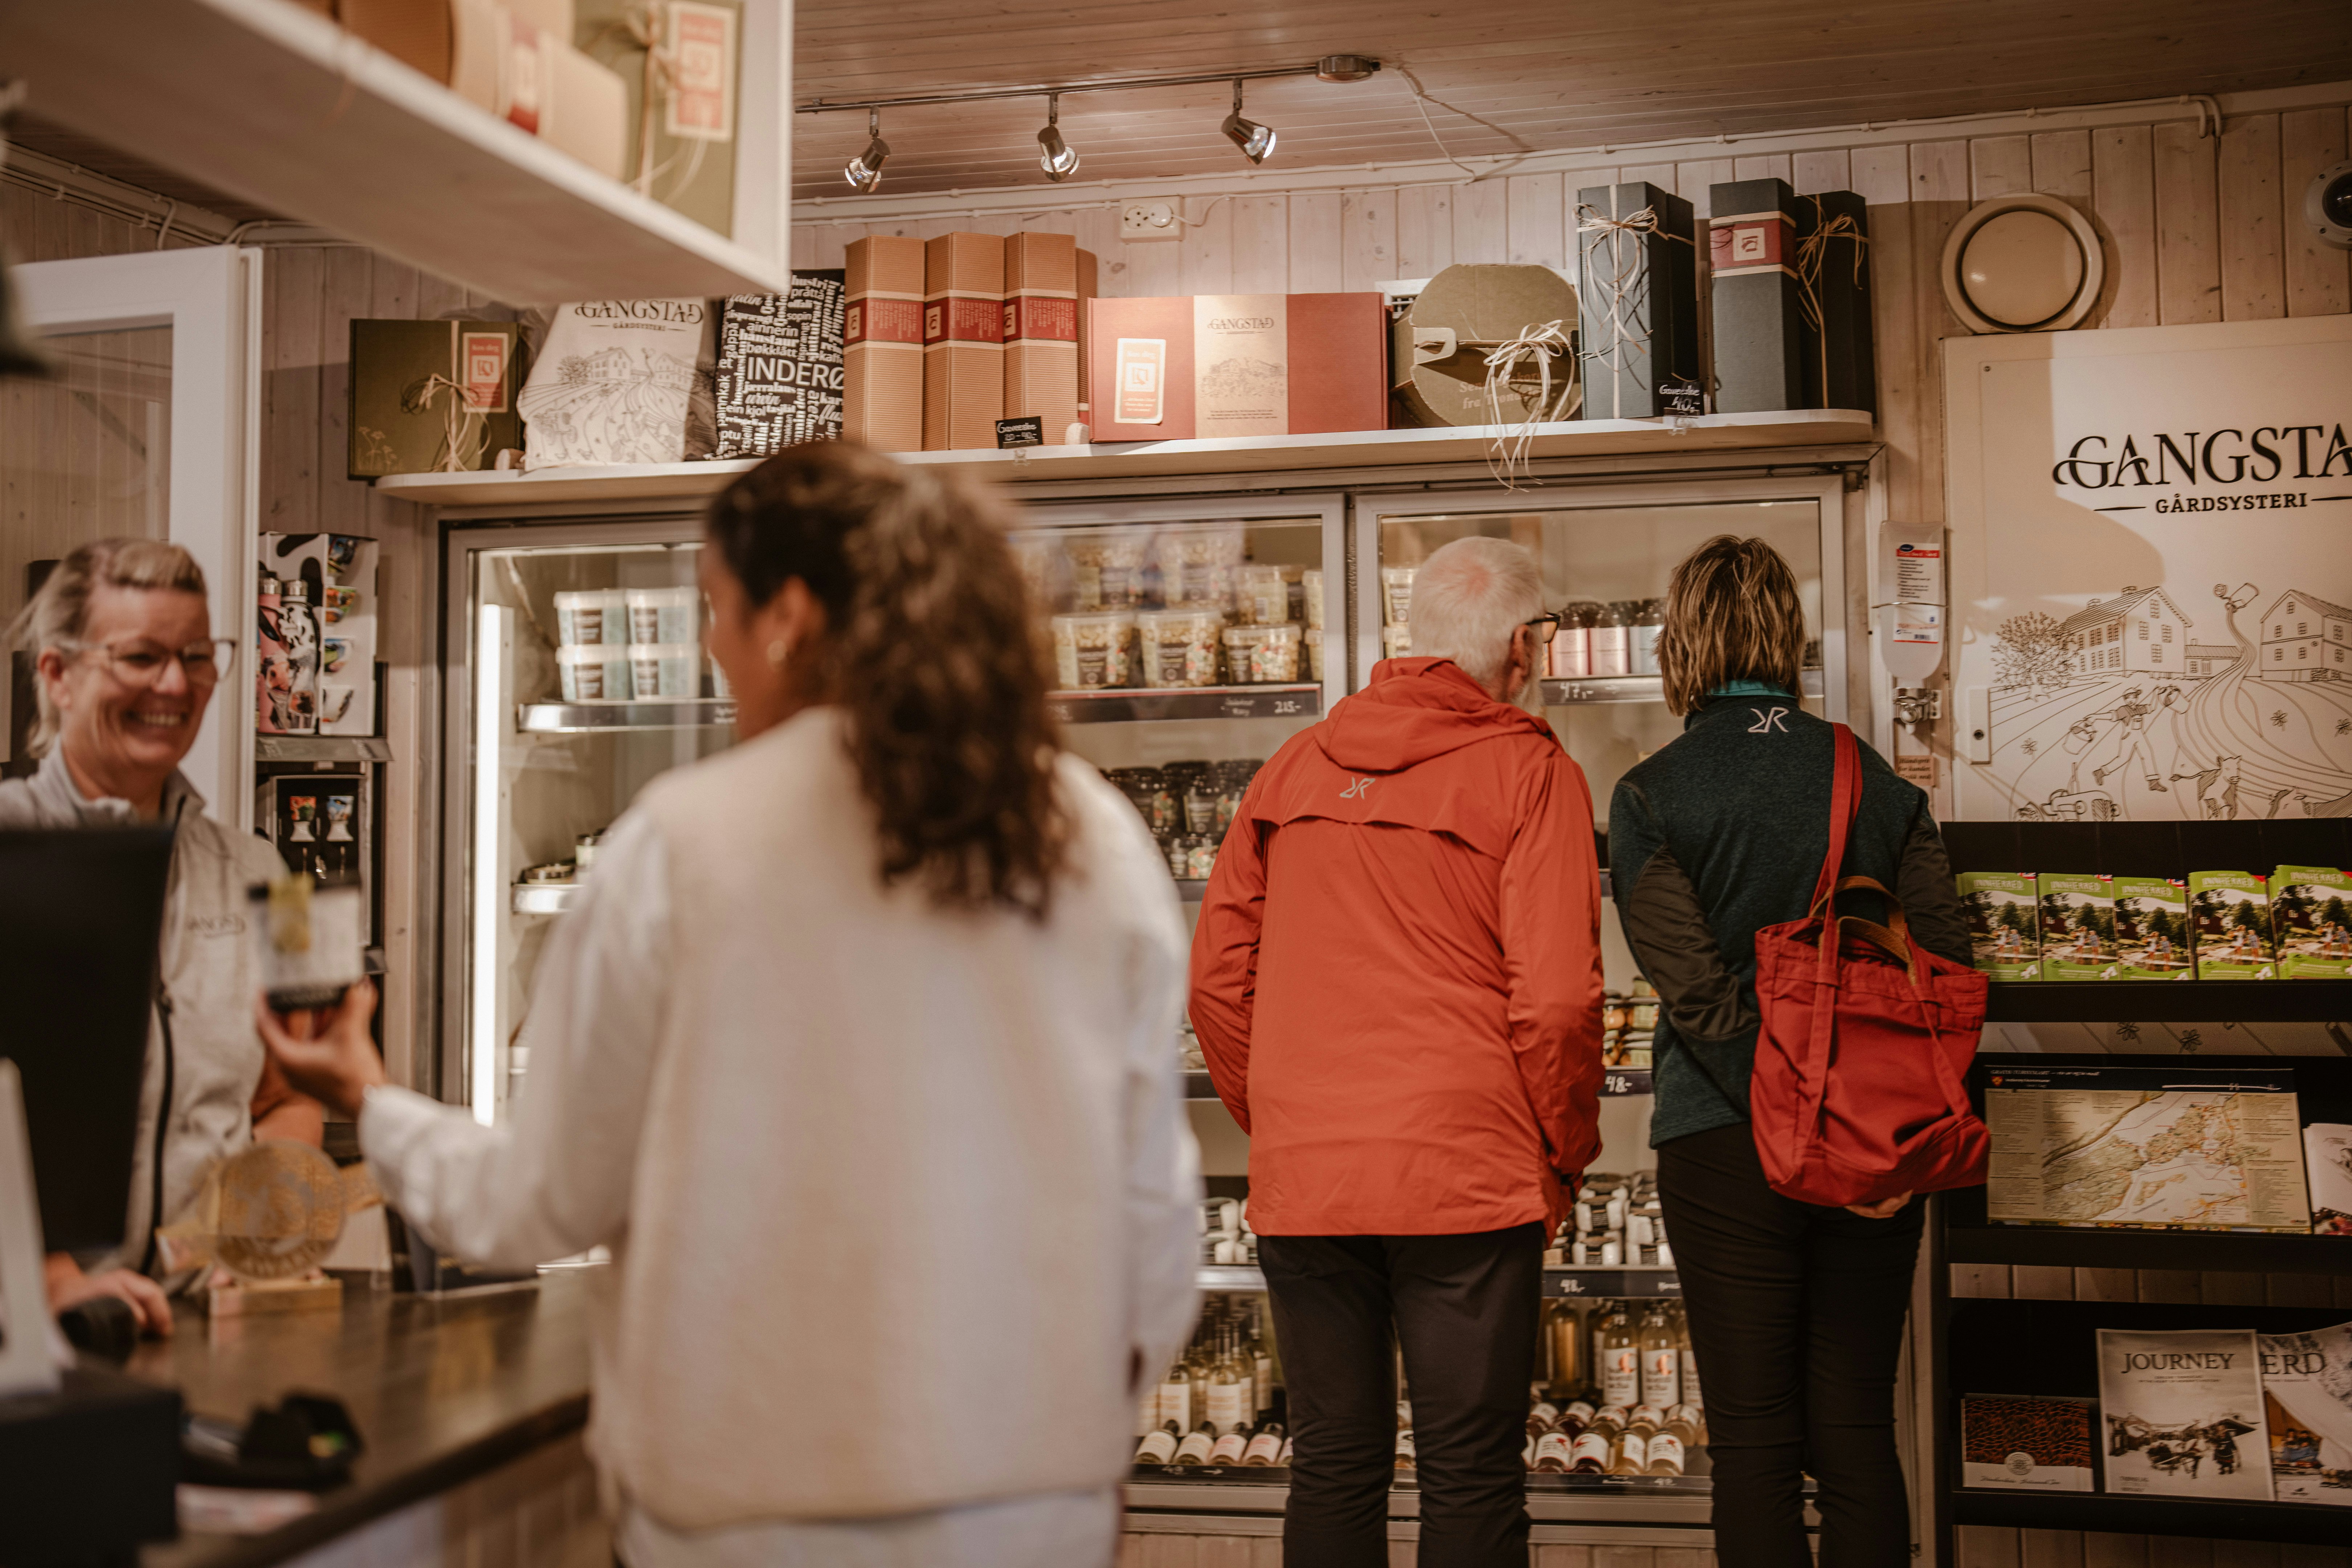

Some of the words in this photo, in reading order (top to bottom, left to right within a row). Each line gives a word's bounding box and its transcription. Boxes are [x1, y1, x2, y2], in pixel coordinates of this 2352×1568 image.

[575, 300, 703, 324] GANGSTAD
[1207, 317, 1275, 330] GANGSTAD
[2051, 423, 2352, 489] GANGSTA
[2156, 493, 2308, 514] GÅRDSYSTERI
[2120, 1353, 2235, 1374] JOURNEY
